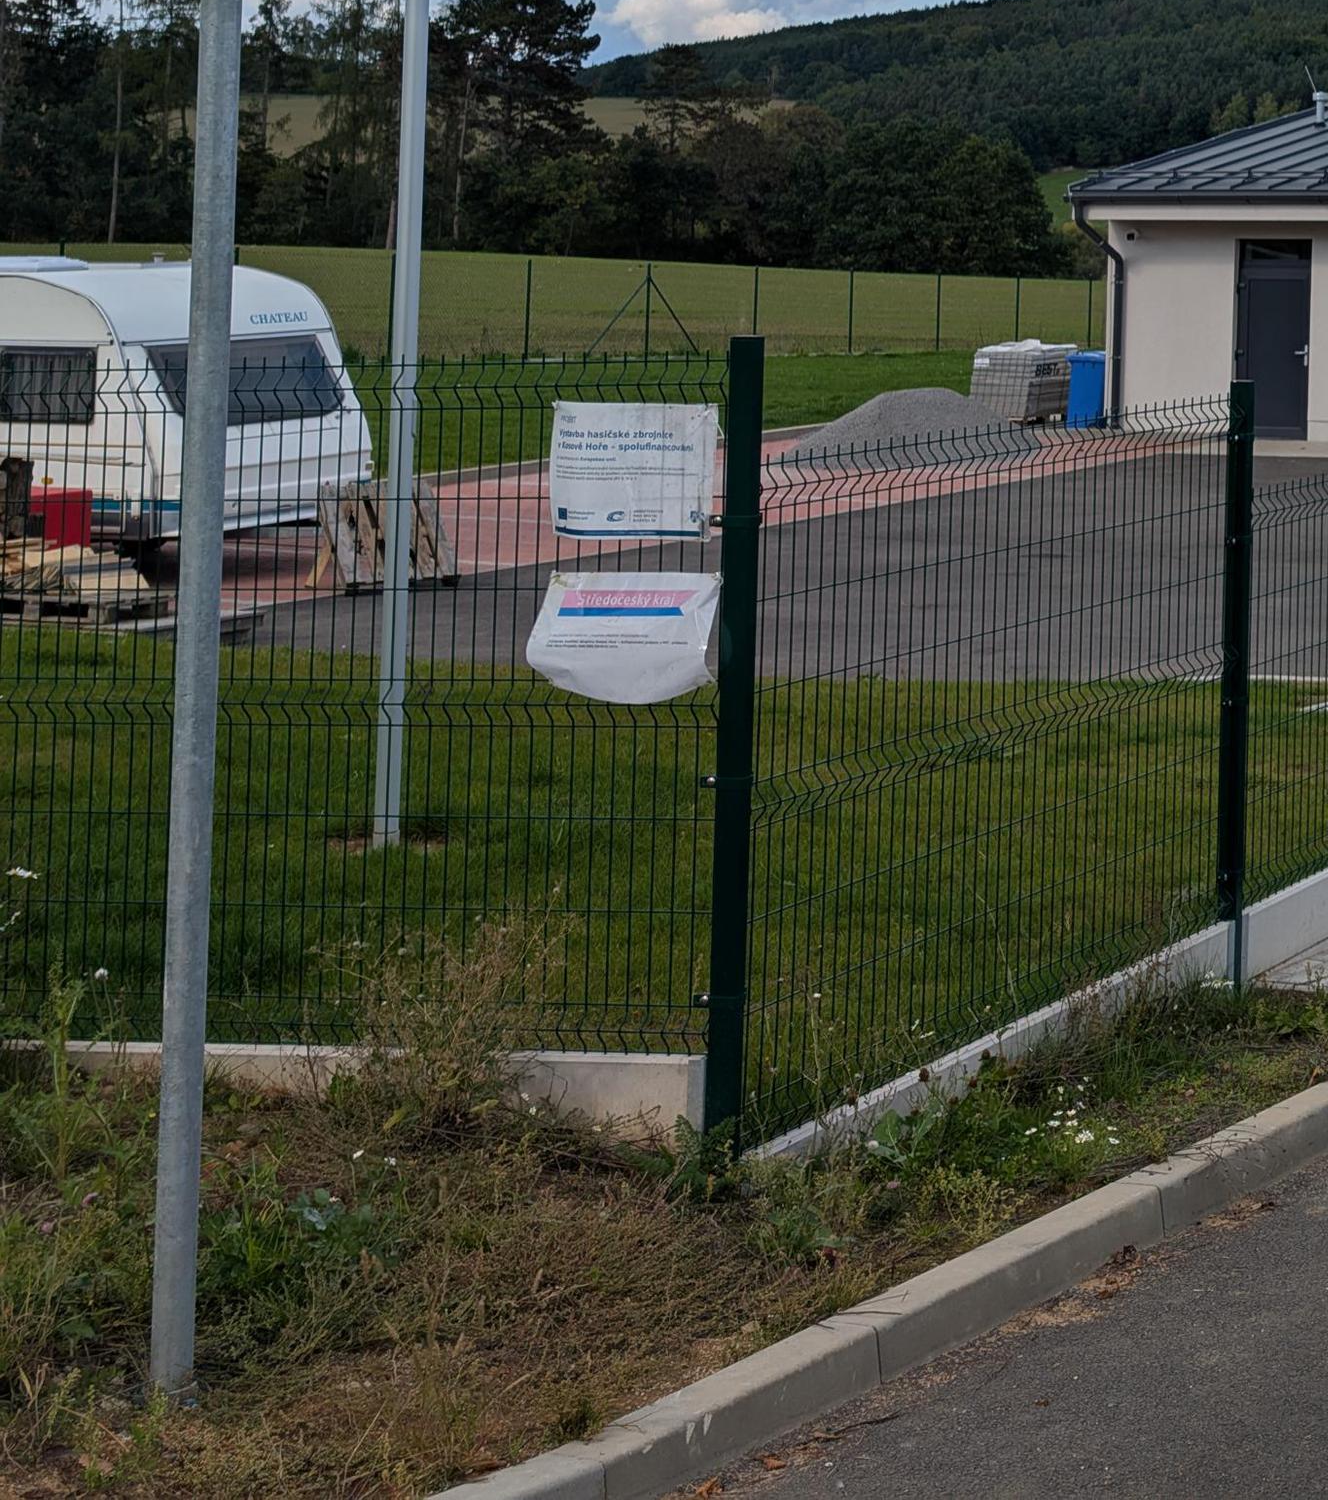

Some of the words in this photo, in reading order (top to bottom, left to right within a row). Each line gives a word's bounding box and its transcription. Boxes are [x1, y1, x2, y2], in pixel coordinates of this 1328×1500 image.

[249, 311, 308, 325] CHATEAU
[1035, 362, 1058, 377] BEST
[587, 429, 630, 439] hasičské
[633, 429, 674, 441] zbrojnice
[585, 441, 608, 451] Hoře
[576, 592, 652, 609] Středočeský
[652, 591, 675, 607] kraj
